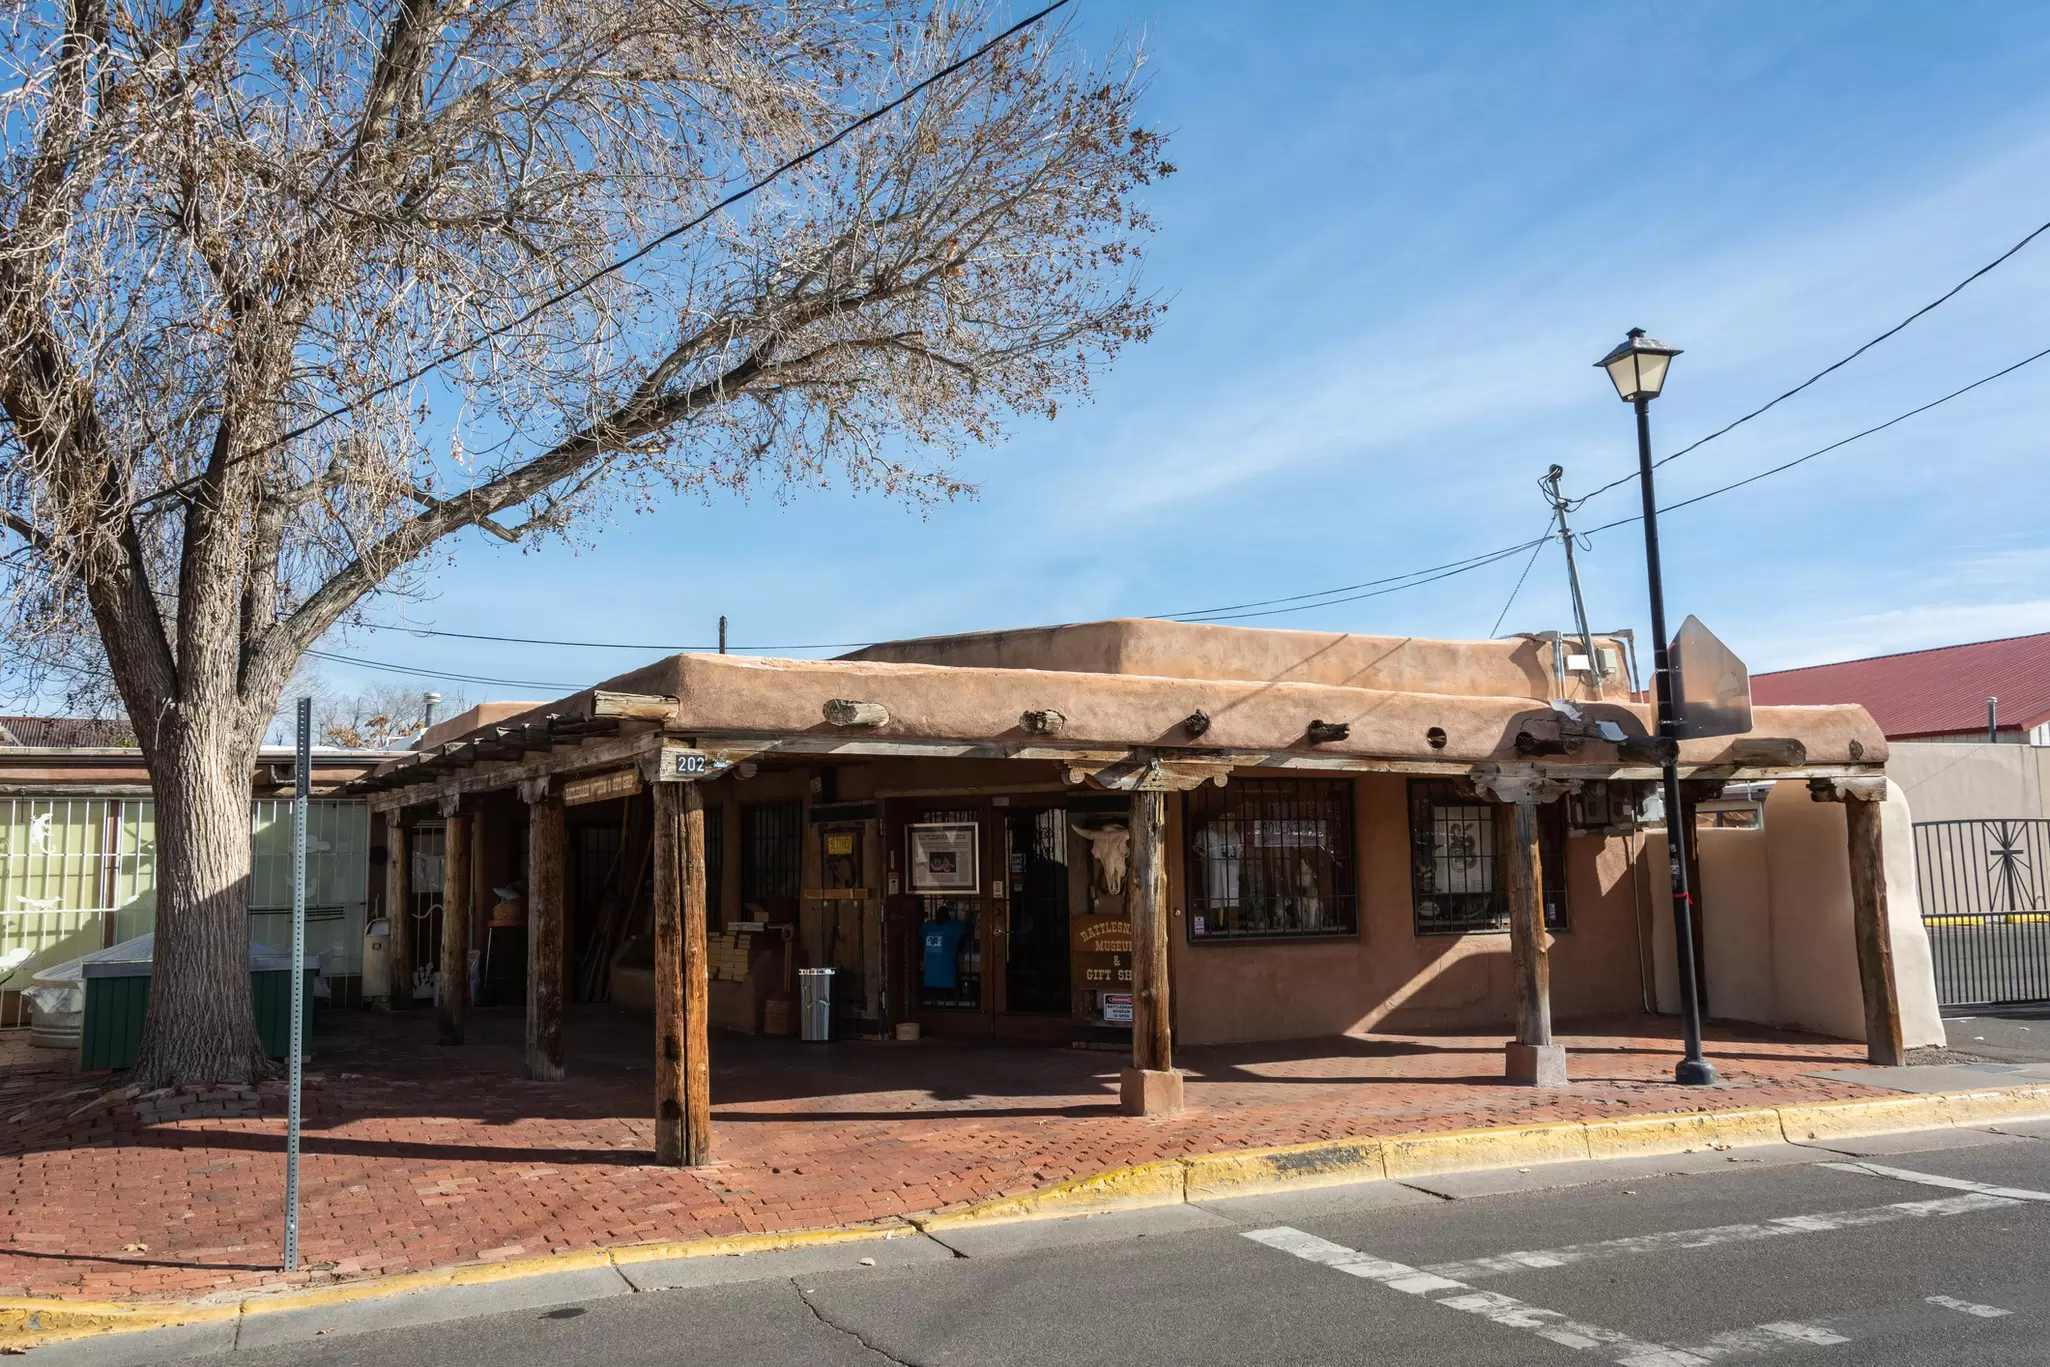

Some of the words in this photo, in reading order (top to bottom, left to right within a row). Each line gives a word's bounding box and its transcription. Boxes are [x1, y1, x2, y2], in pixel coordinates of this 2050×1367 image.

[678, 756, 705, 772] 202
[1080, 921, 1132, 943] RATTLESN
[1113, 955, 1121, 967] &
[1086, 969, 1112, 981] GIFT
[1117, 969, 1132, 981] SH
